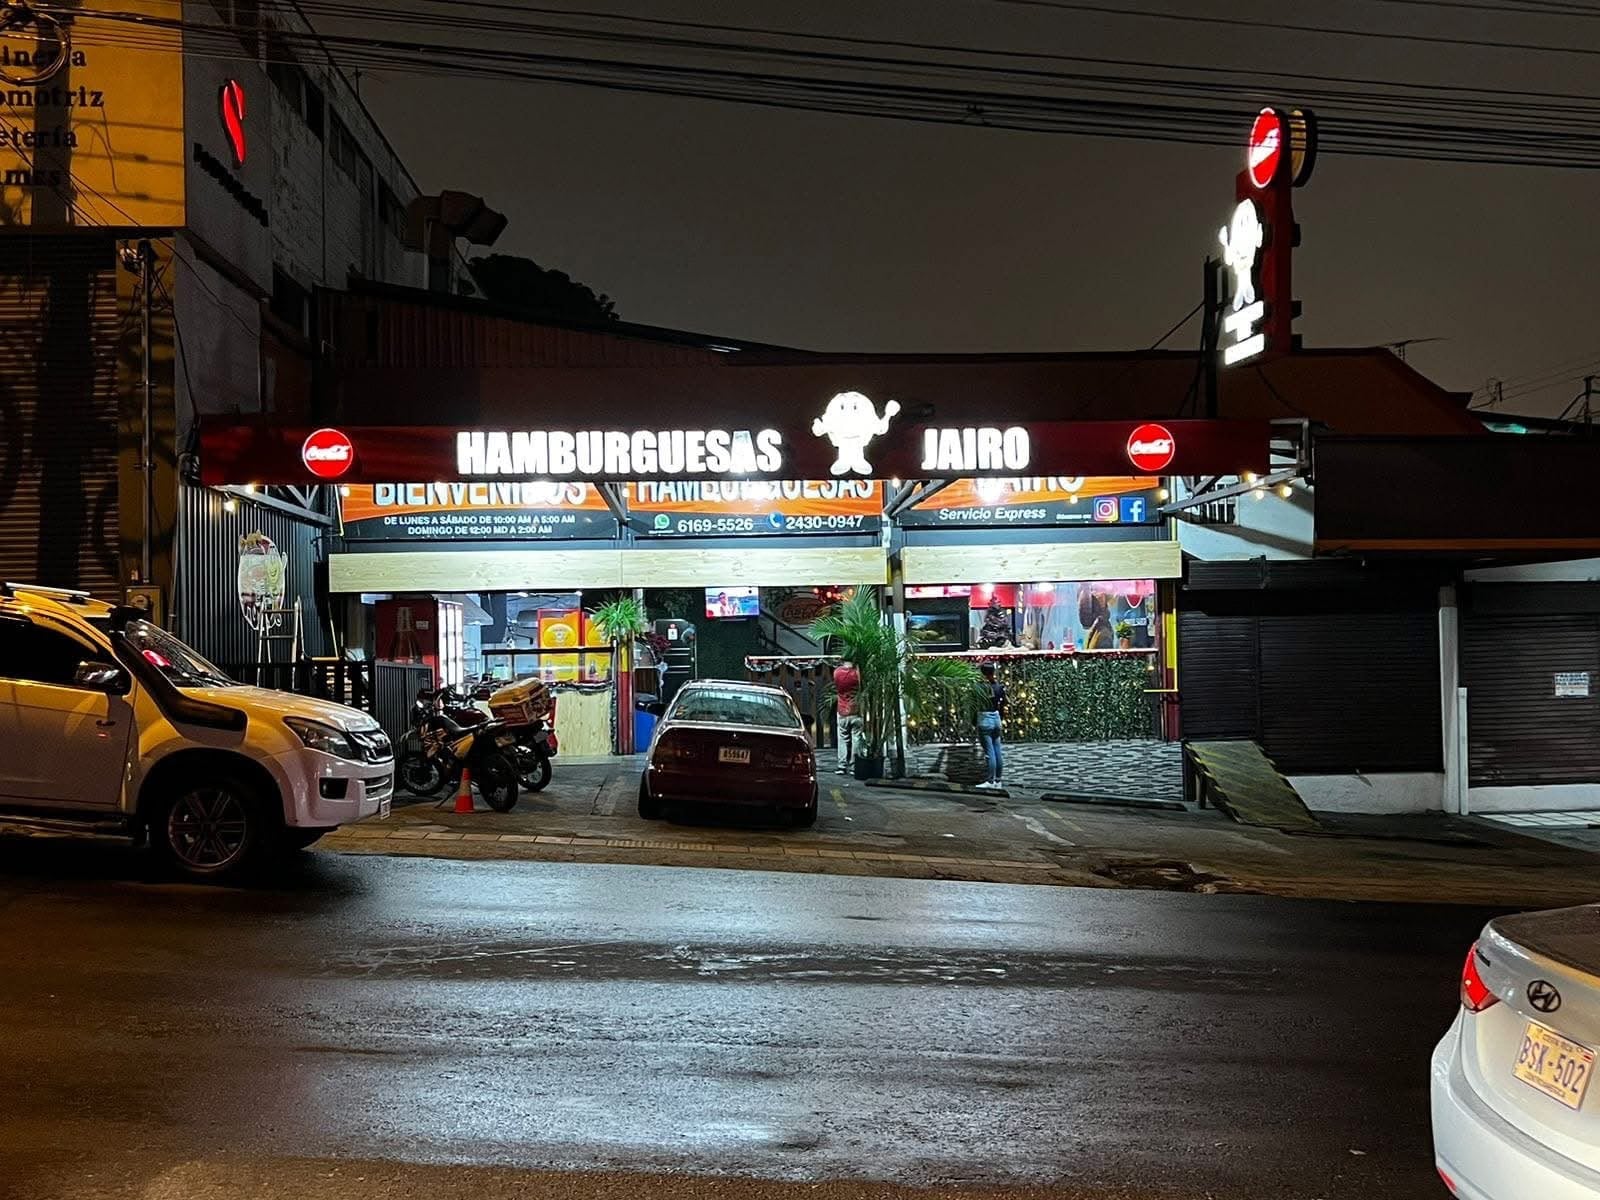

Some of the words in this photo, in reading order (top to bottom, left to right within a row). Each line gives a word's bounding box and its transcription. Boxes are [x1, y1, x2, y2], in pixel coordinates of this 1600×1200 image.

[457, 430, 782, 477] HAMBURGUESAS
[921, 427, 1031, 471] JAIRO
[374, 481, 587, 506] BIENVENIOS
[384, 516, 398, 525] DE
[399, 516, 430, 525] LUNES
[431, 516, 439, 525] A
[440, 514, 477, 525] SÁBADO
[479, 516, 492, 524] DE
[493, 515, 517, 524] 10:00
[517, 515, 532, 523] AM
[533, 515, 540, 523] A
[561, 514, 576, 523] AM
[785, 514, 864, 530] 2430-0947
[938, 507, 991, 520] Servicio
[994, 507, 1047, 521] Express
[407, 526, 453, 535] DOMINGO
[455, 526, 468, 534] DE
[469, 526, 492, 534] 12:00
[509, 526, 517, 534] A
[518, 526, 537, 534] 2:00
[538, 525, 553, 534] AM
[677, 517, 754, 533] 6169-5526
